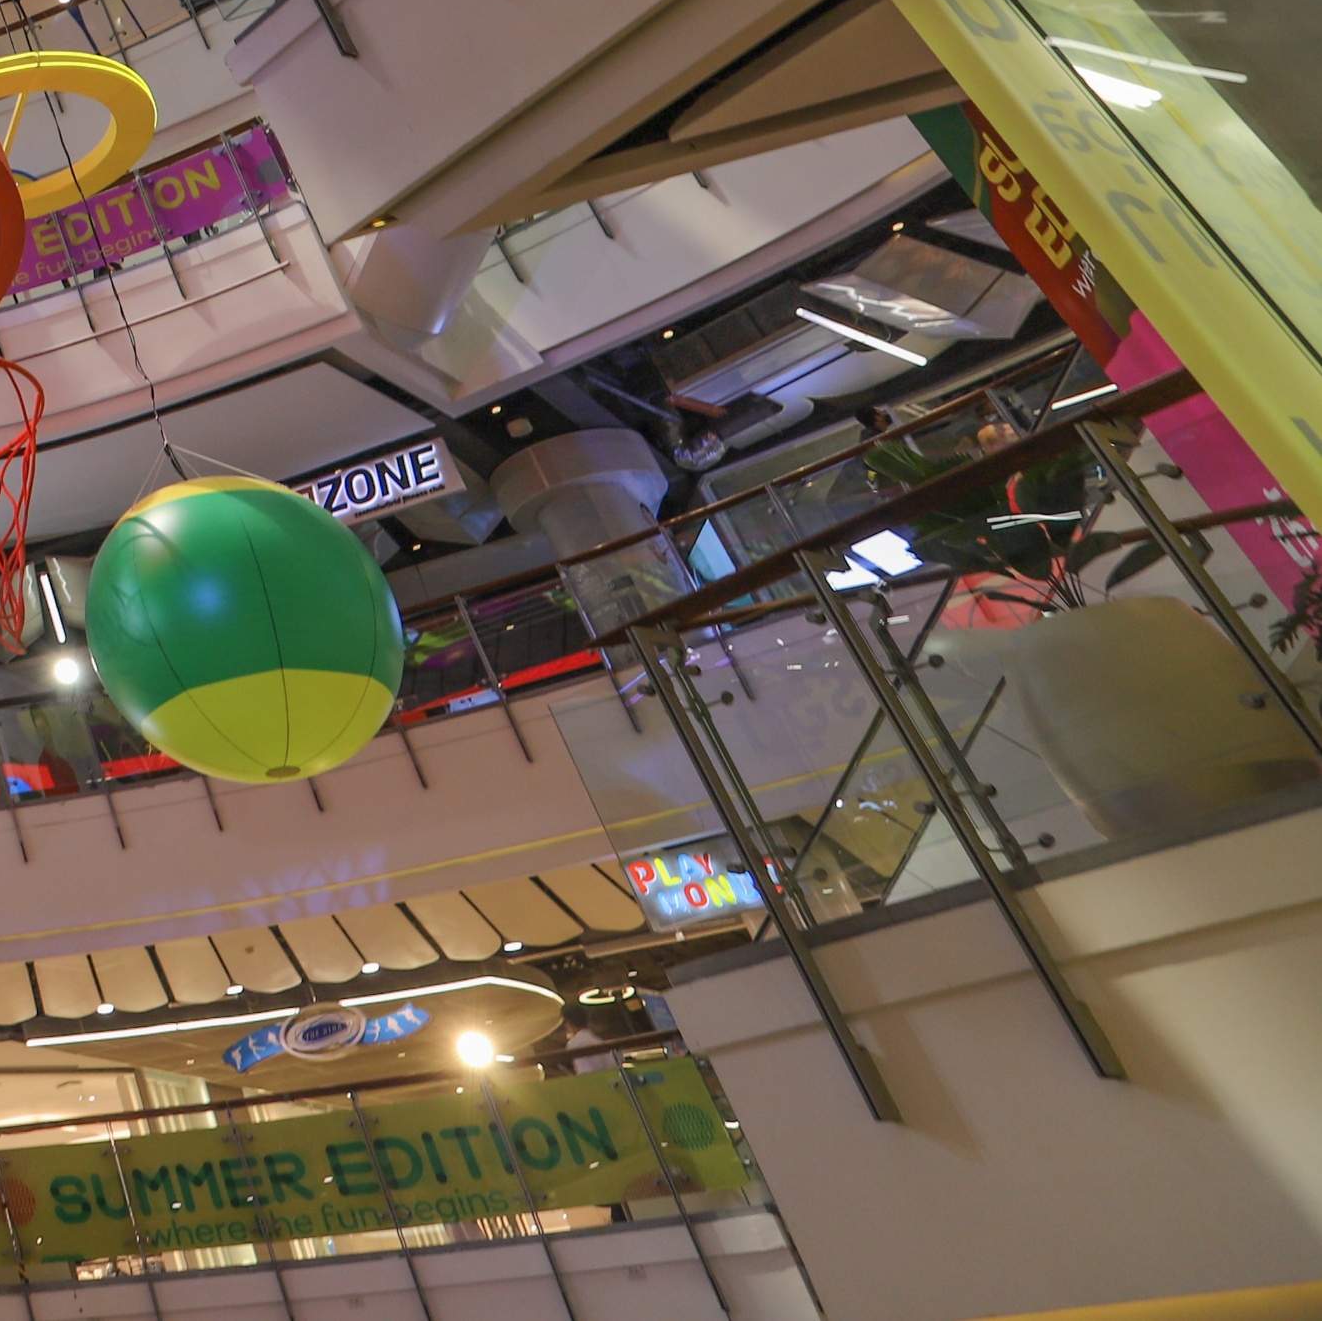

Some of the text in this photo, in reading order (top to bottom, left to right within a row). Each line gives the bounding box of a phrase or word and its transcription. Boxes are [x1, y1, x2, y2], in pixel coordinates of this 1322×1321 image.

[31, 159, 222, 256] EDITON
[83, 224, 165, 264] begin
[300, 444, 440, 514] ZONE
[627, 852, 715, 896] PLAY
[50, 1107, 618, 1225] SUMMER EDITION
[149, 1219, 248, 1248] where
[321, 1203, 380, 1231] fun
